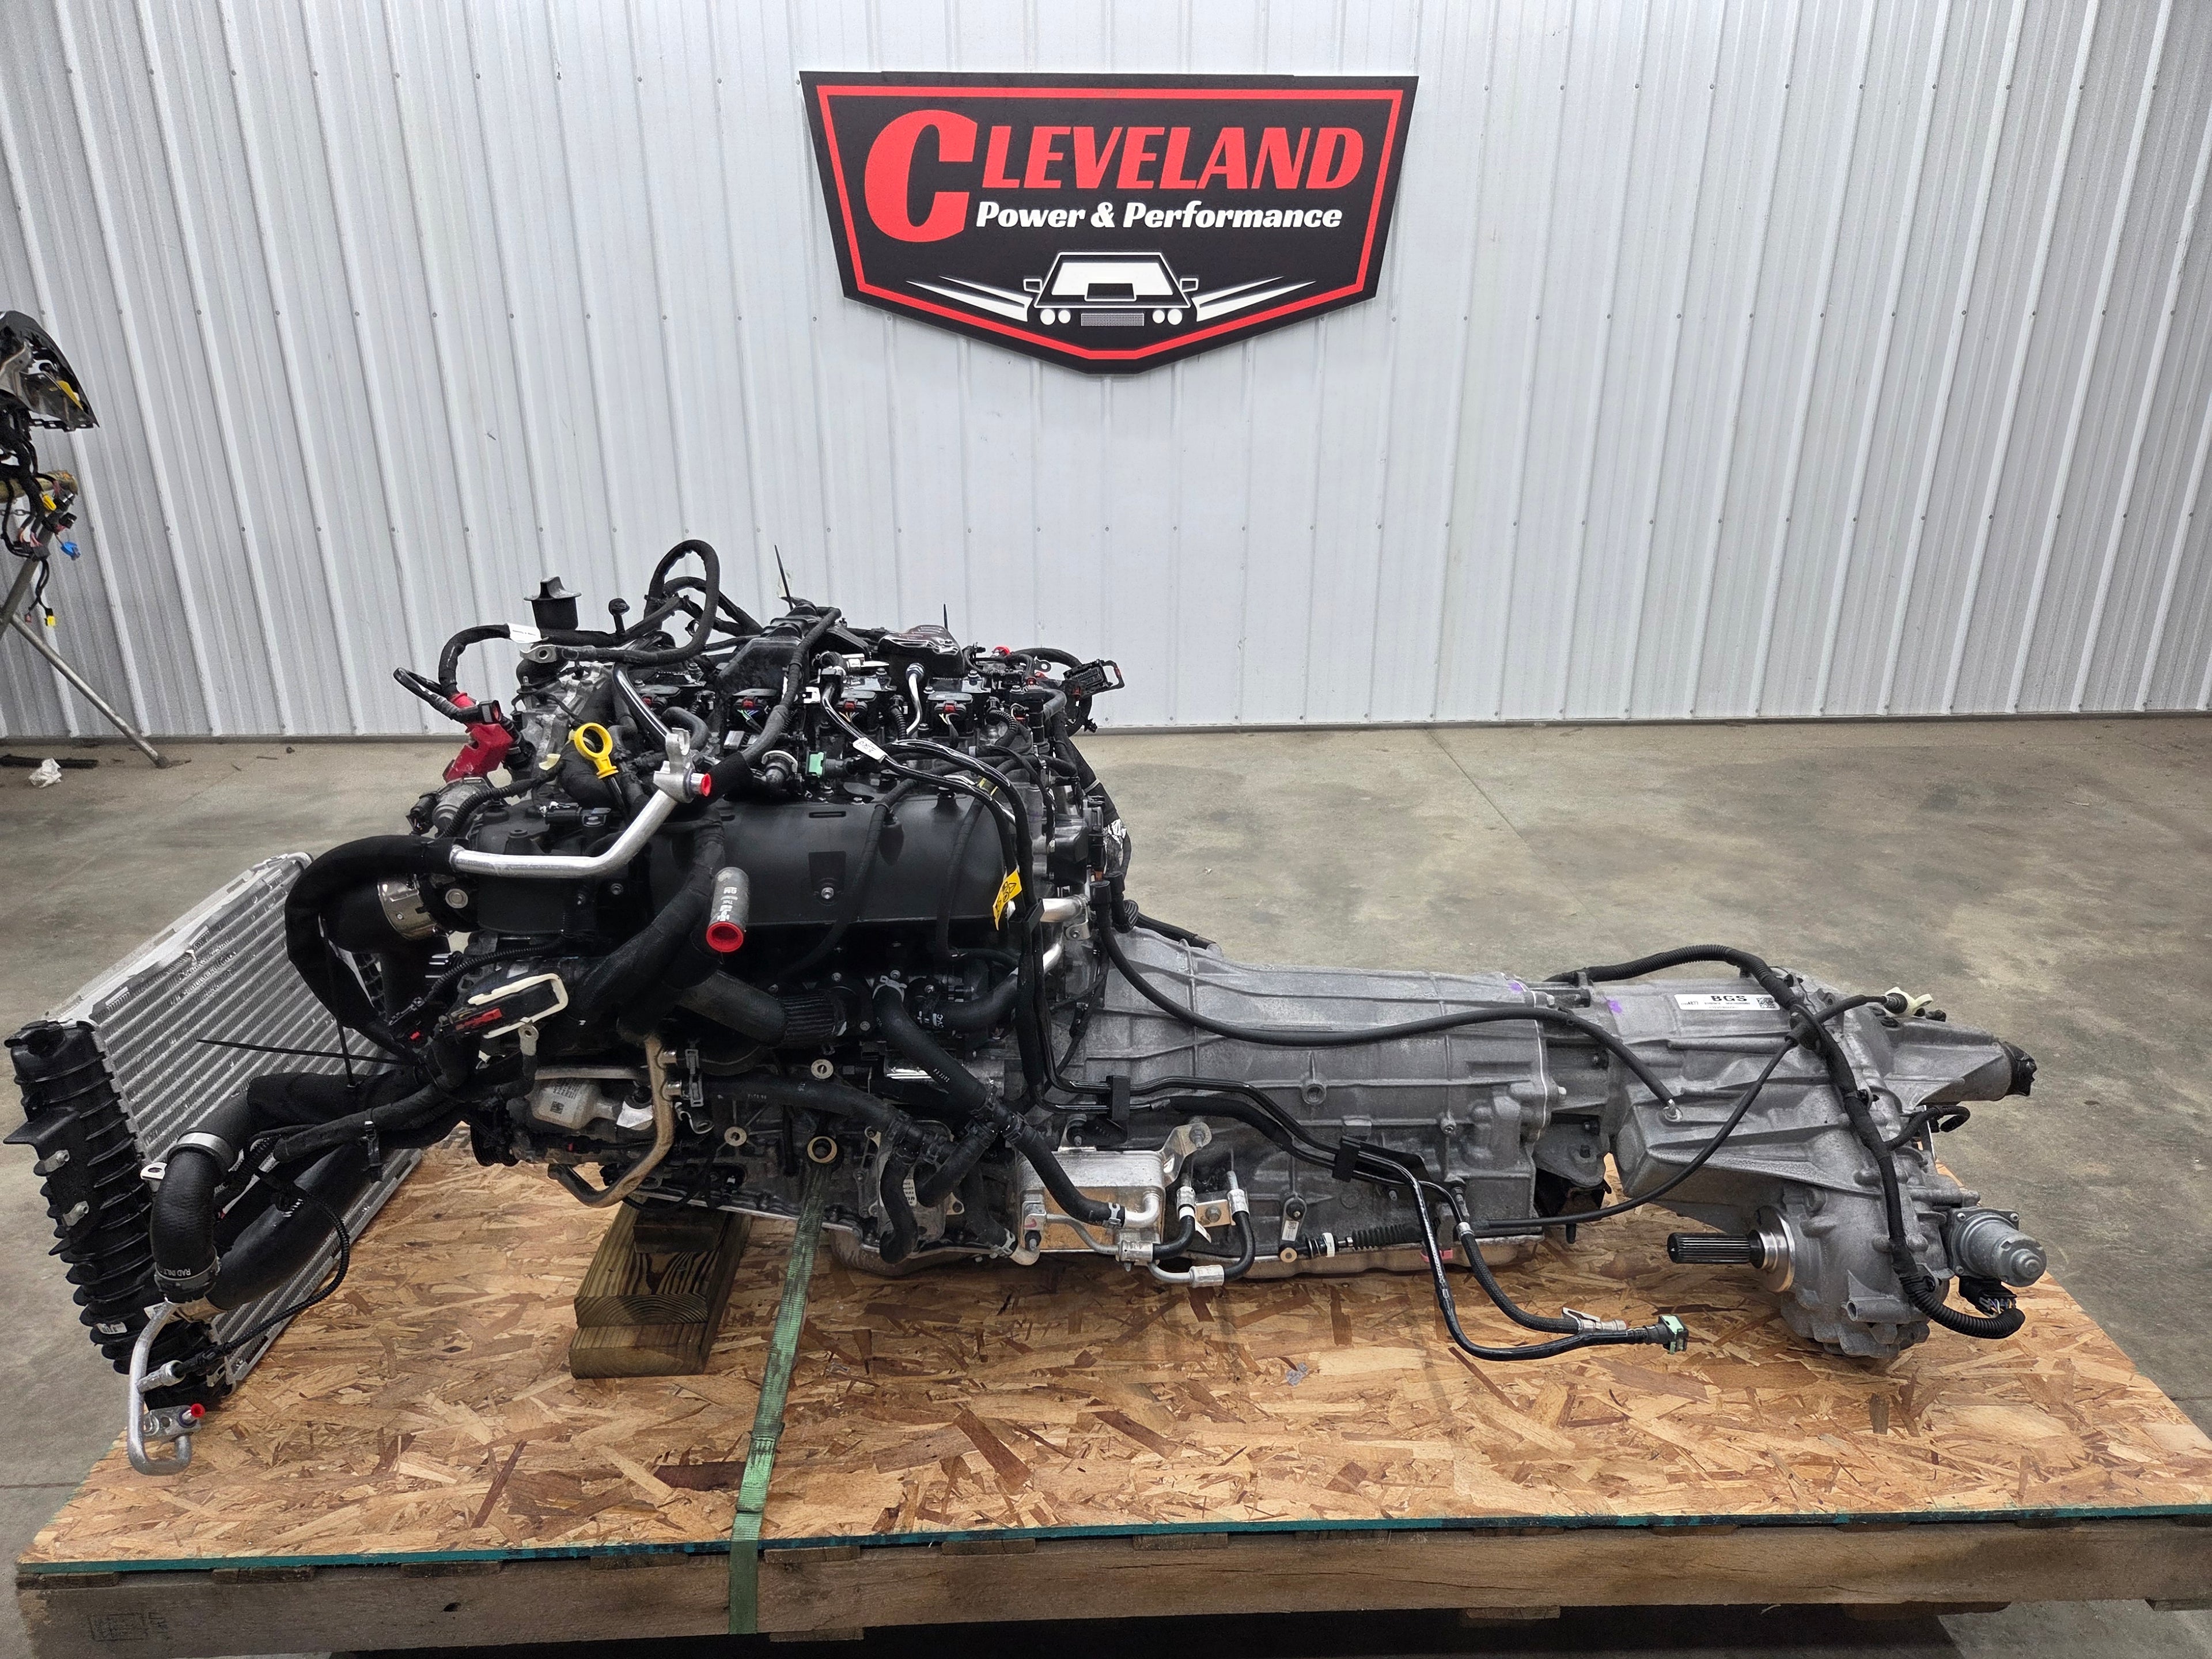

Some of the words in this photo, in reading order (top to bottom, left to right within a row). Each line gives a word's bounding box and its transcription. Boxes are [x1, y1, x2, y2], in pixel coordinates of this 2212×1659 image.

[865, 109, 1363, 242] CLEVELAND
[976, 201, 1086, 228] Power
[1090, 202, 1116, 228] &
[1123, 200, 1343, 228] Performance
